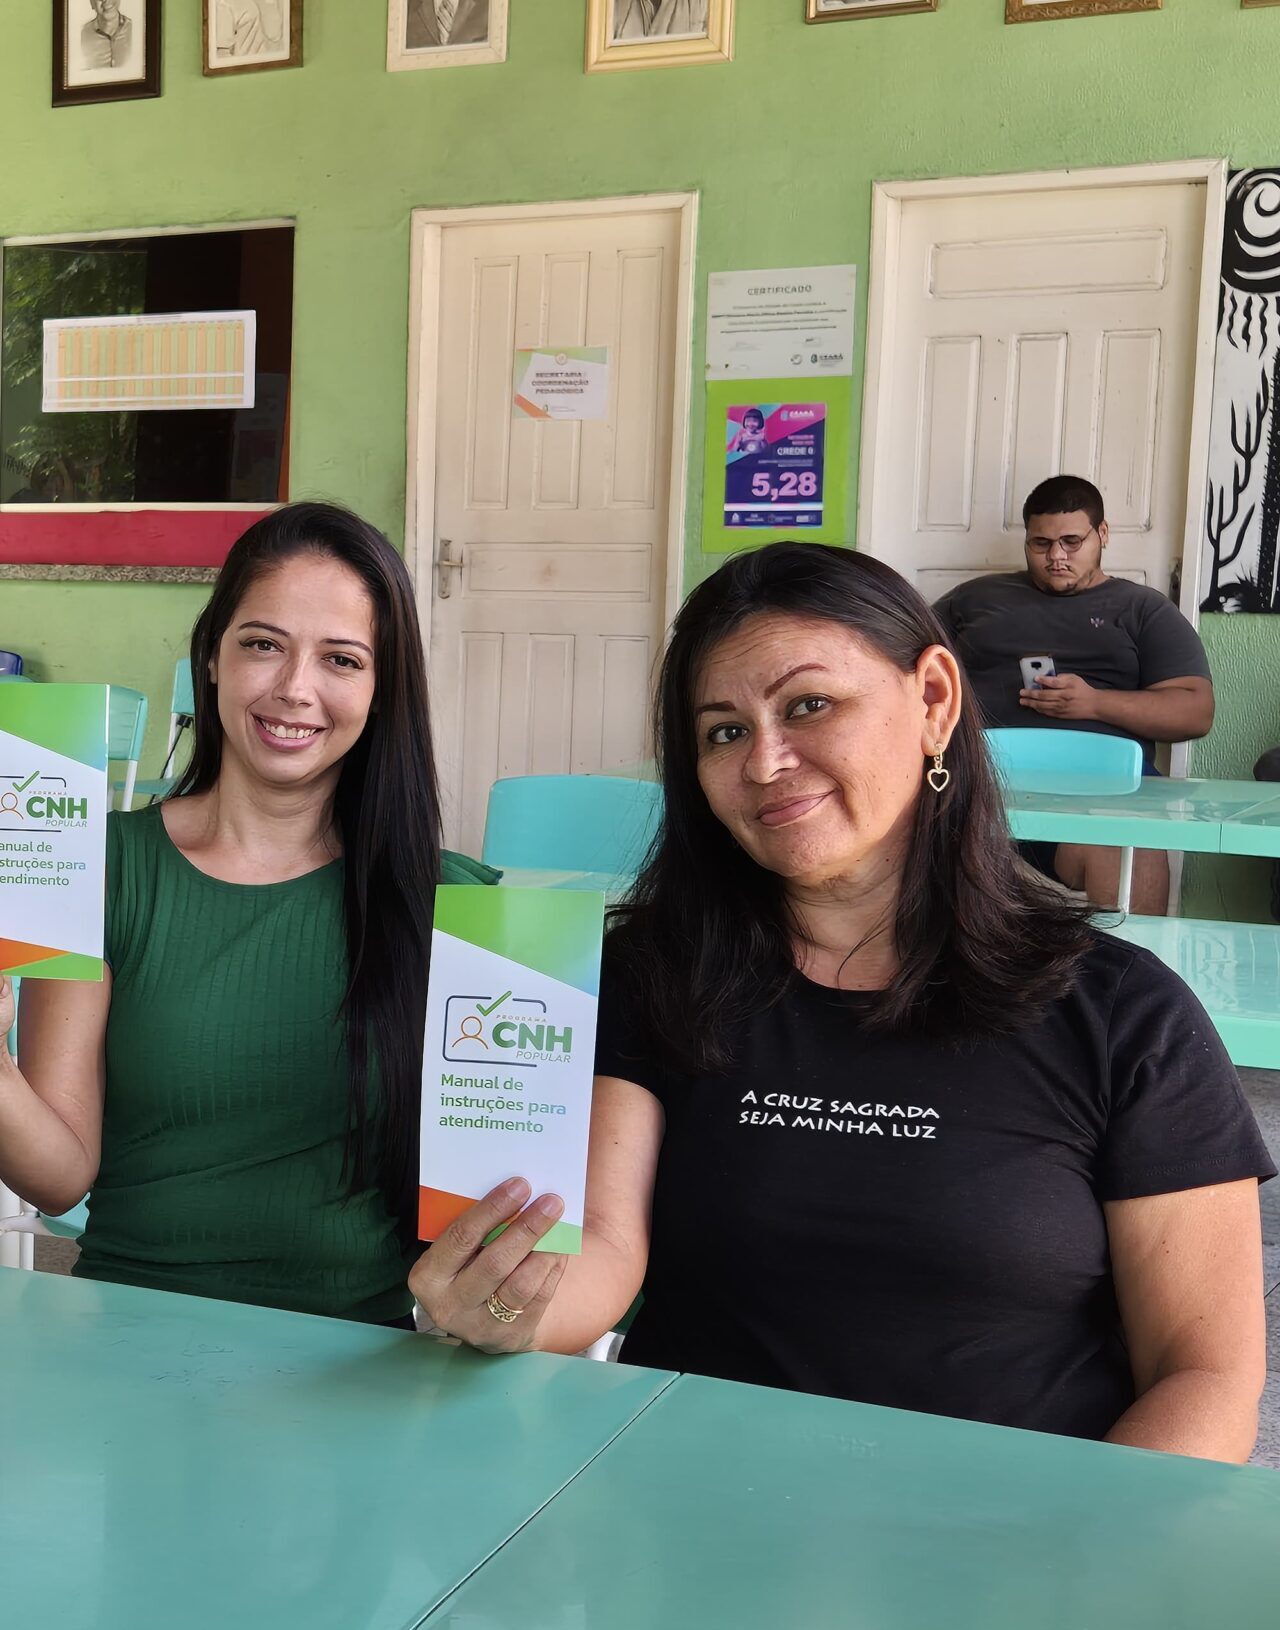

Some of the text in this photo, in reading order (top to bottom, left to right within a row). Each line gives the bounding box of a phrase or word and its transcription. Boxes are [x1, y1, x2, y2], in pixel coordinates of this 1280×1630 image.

[747, 284, 812, 296] CERTIFICADO
[751, 471, 817, 502] 5,28
[26, 796, 88, 819] CNH
[45, 819, 88, 828] POPULAR
[36, 841, 52, 853] de
[57, 861, 86, 872] para
[496, 1014, 548, 1022] PROGRAMA
[492, 1021, 573, 1053] CNH
[516, 1050, 571, 1063] POPULAR
[441, 1073, 524, 1091] Manual de
[440, 1093, 567, 1116] instruções para
[741, 1090, 940, 1119] A CRUZ SAGRADA
[439, 1114, 544, 1133] atendimento
[739, 1110, 937, 1139] SEJA MINHA LUZ
